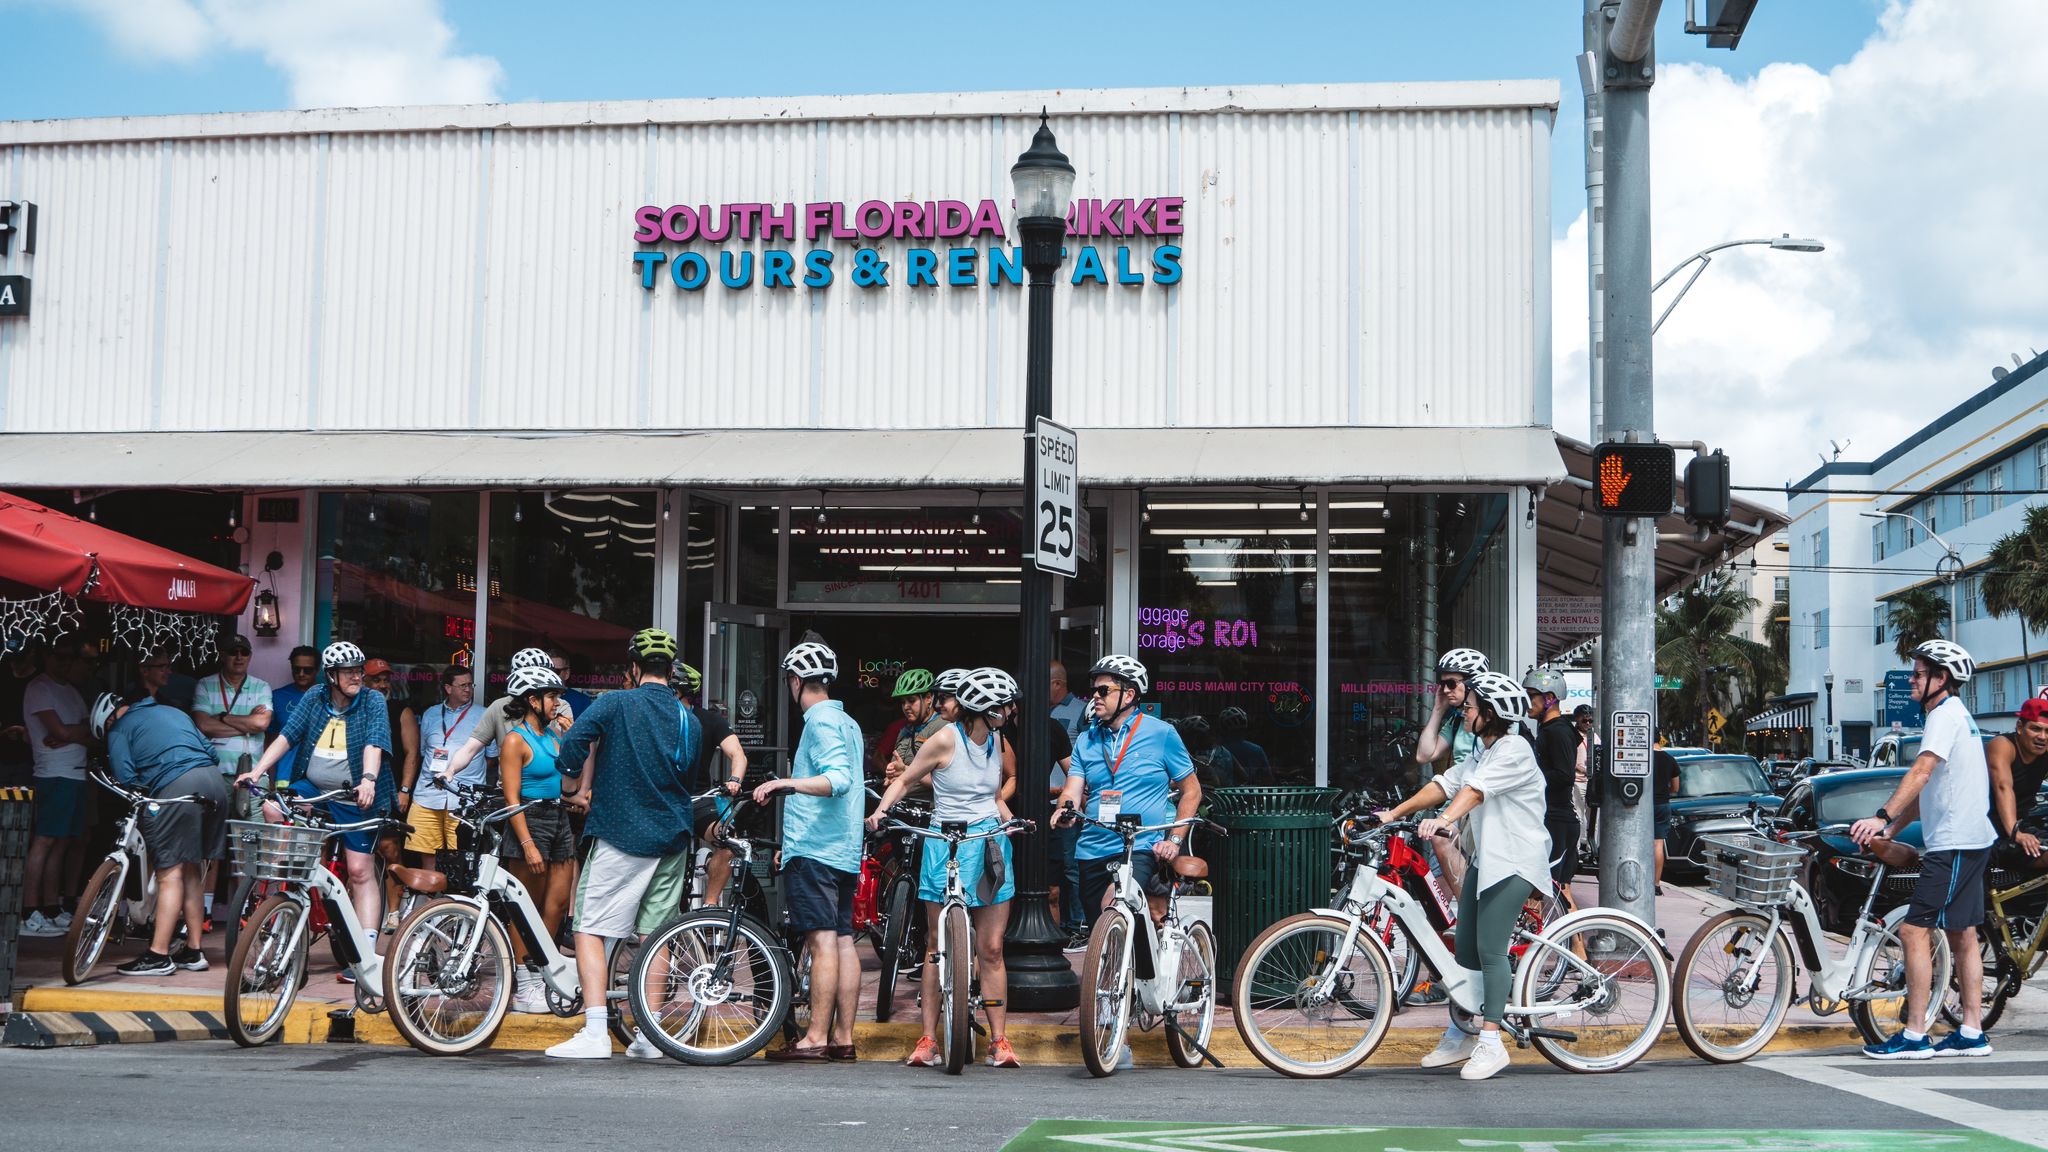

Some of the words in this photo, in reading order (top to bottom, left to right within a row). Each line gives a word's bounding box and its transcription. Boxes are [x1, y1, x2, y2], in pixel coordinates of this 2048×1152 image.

[634, 203, 796, 244] SOUTH
[805, 199, 1005, 241] FLORIDA
[1012, 196, 1184, 239] IKKE
[633, 249, 835, 290] TOURS
[851, 248, 889, 288] &
[906, 245, 1184, 288] RENALS
[1039, 434, 1075, 466] SPEED
[1043, 467, 1071, 496] LIMIT
[1039, 499, 1074, 559] 25
[168, 577, 196, 600] AMALFI
[897, 579, 942, 599] 1401
[1551, 616, 1557, 624] &
[1560, 616, 1600, 624] RENTALS
[571, 673, 605, 685] SCUBA
[1156, 681, 1176, 692] BIG
[1178, 681, 1202, 692] BUS
[1204, 681, 1237, 692] MIAMI
[1240, 681, 1265, 692] CITY
[1267, 681, 1299, 693] TOUR
[1432, 880, 1450, 911] OTAOLA
